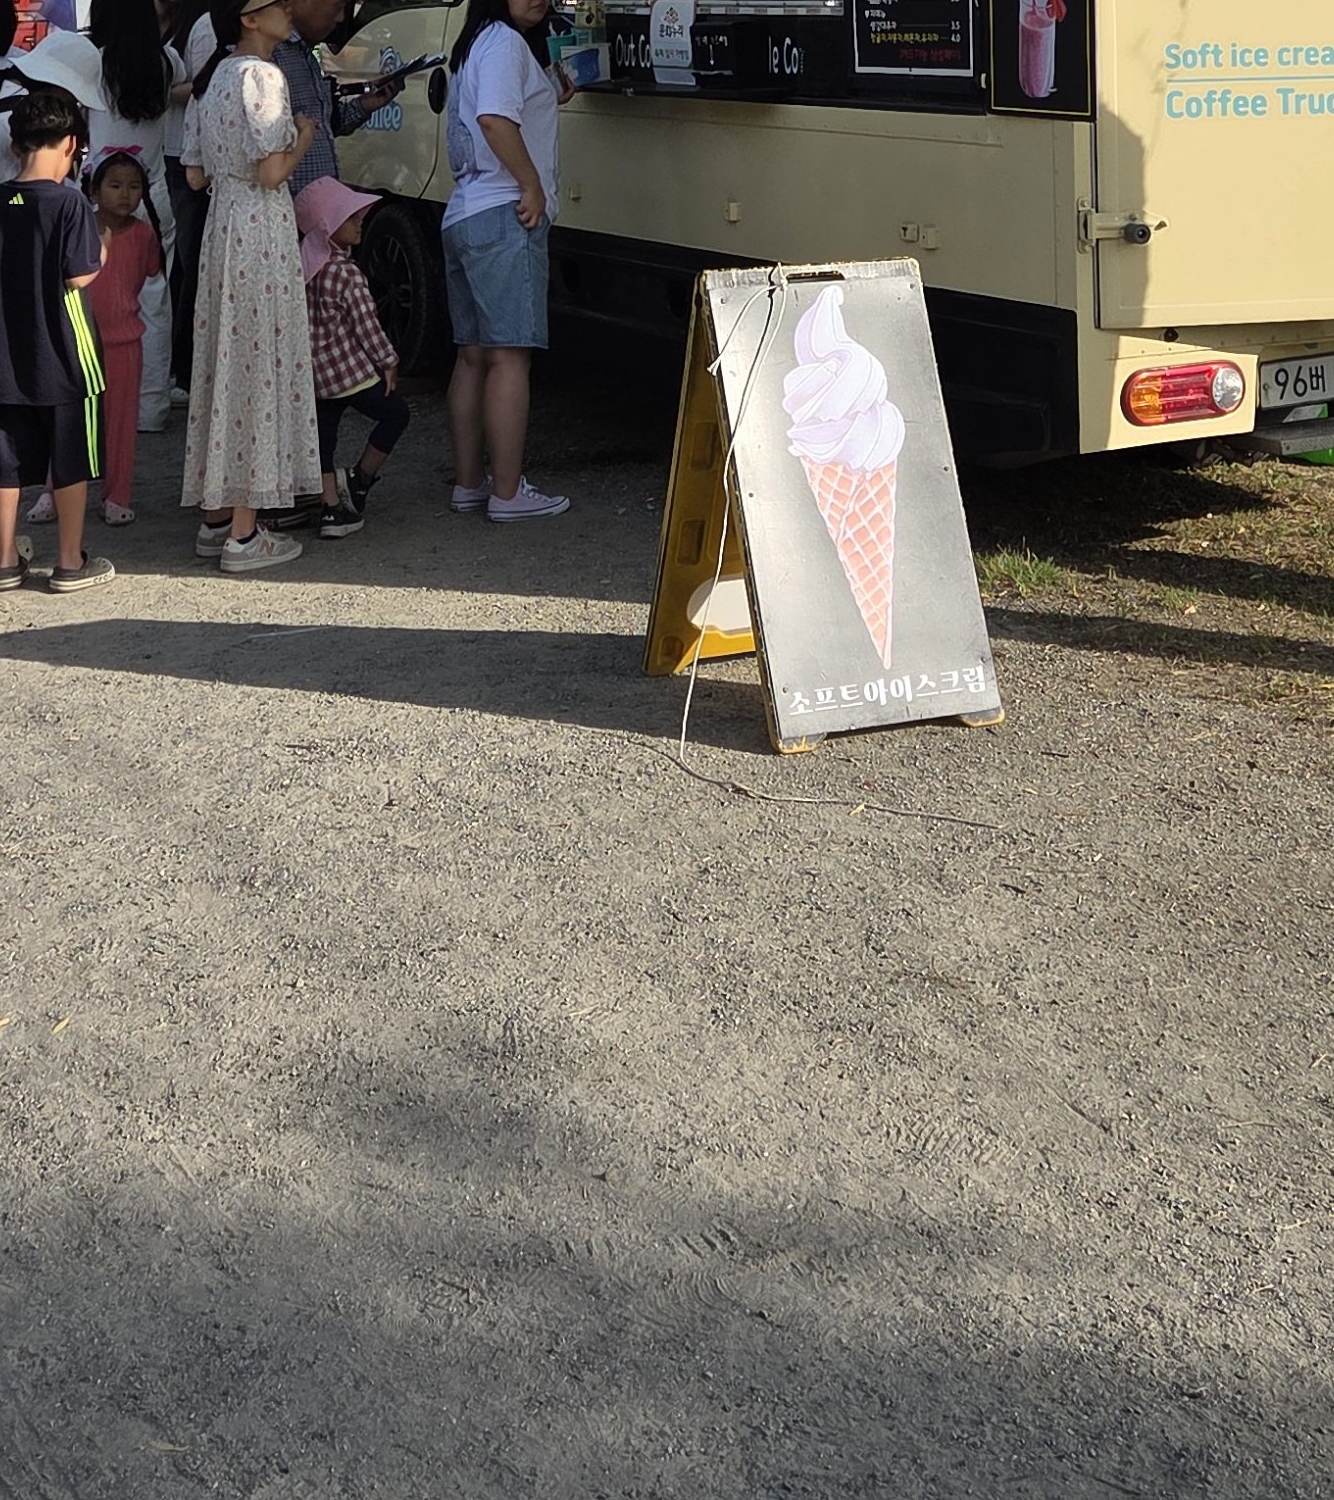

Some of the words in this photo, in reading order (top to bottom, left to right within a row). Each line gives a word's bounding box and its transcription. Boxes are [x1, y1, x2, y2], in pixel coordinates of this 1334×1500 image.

[615, 32, 636, 68] Out
[1165, 42, 1224, 69] Soft
[1230, 42, 1269, 68] ice
[1166, 88, 1268, 119] Coffee
[1274, 364, 1326, 400] 96버
[788, 664, 987, 717] 소프트아이스크림
